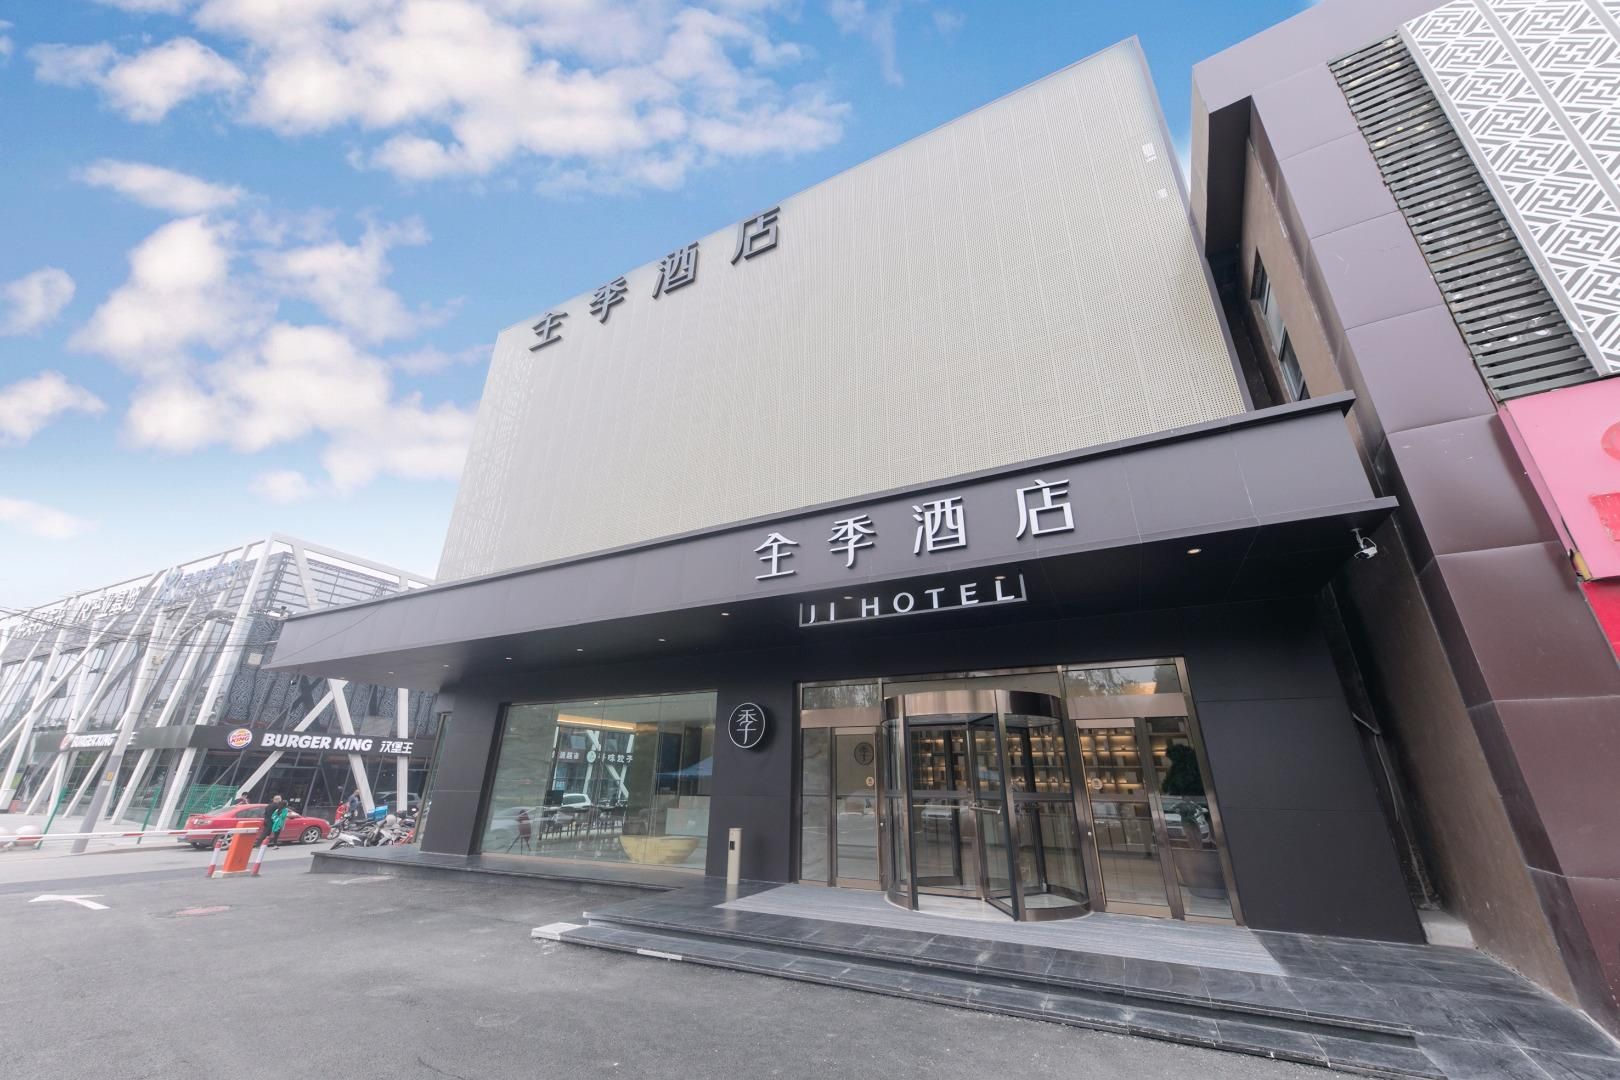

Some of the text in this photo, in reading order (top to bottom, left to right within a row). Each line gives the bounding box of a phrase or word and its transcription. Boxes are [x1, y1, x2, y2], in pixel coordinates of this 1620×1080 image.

[529, 206, 780, 351] 全季酒店
[754, 479, 1075, 580] 全季酒店
[809, 579, 1015, 623] JI HOTEL
[261, 733, 373, 751] BURGER KING
[736, 709, 758, 744] 季
[379, 740, 413, 754] 汉堡王
